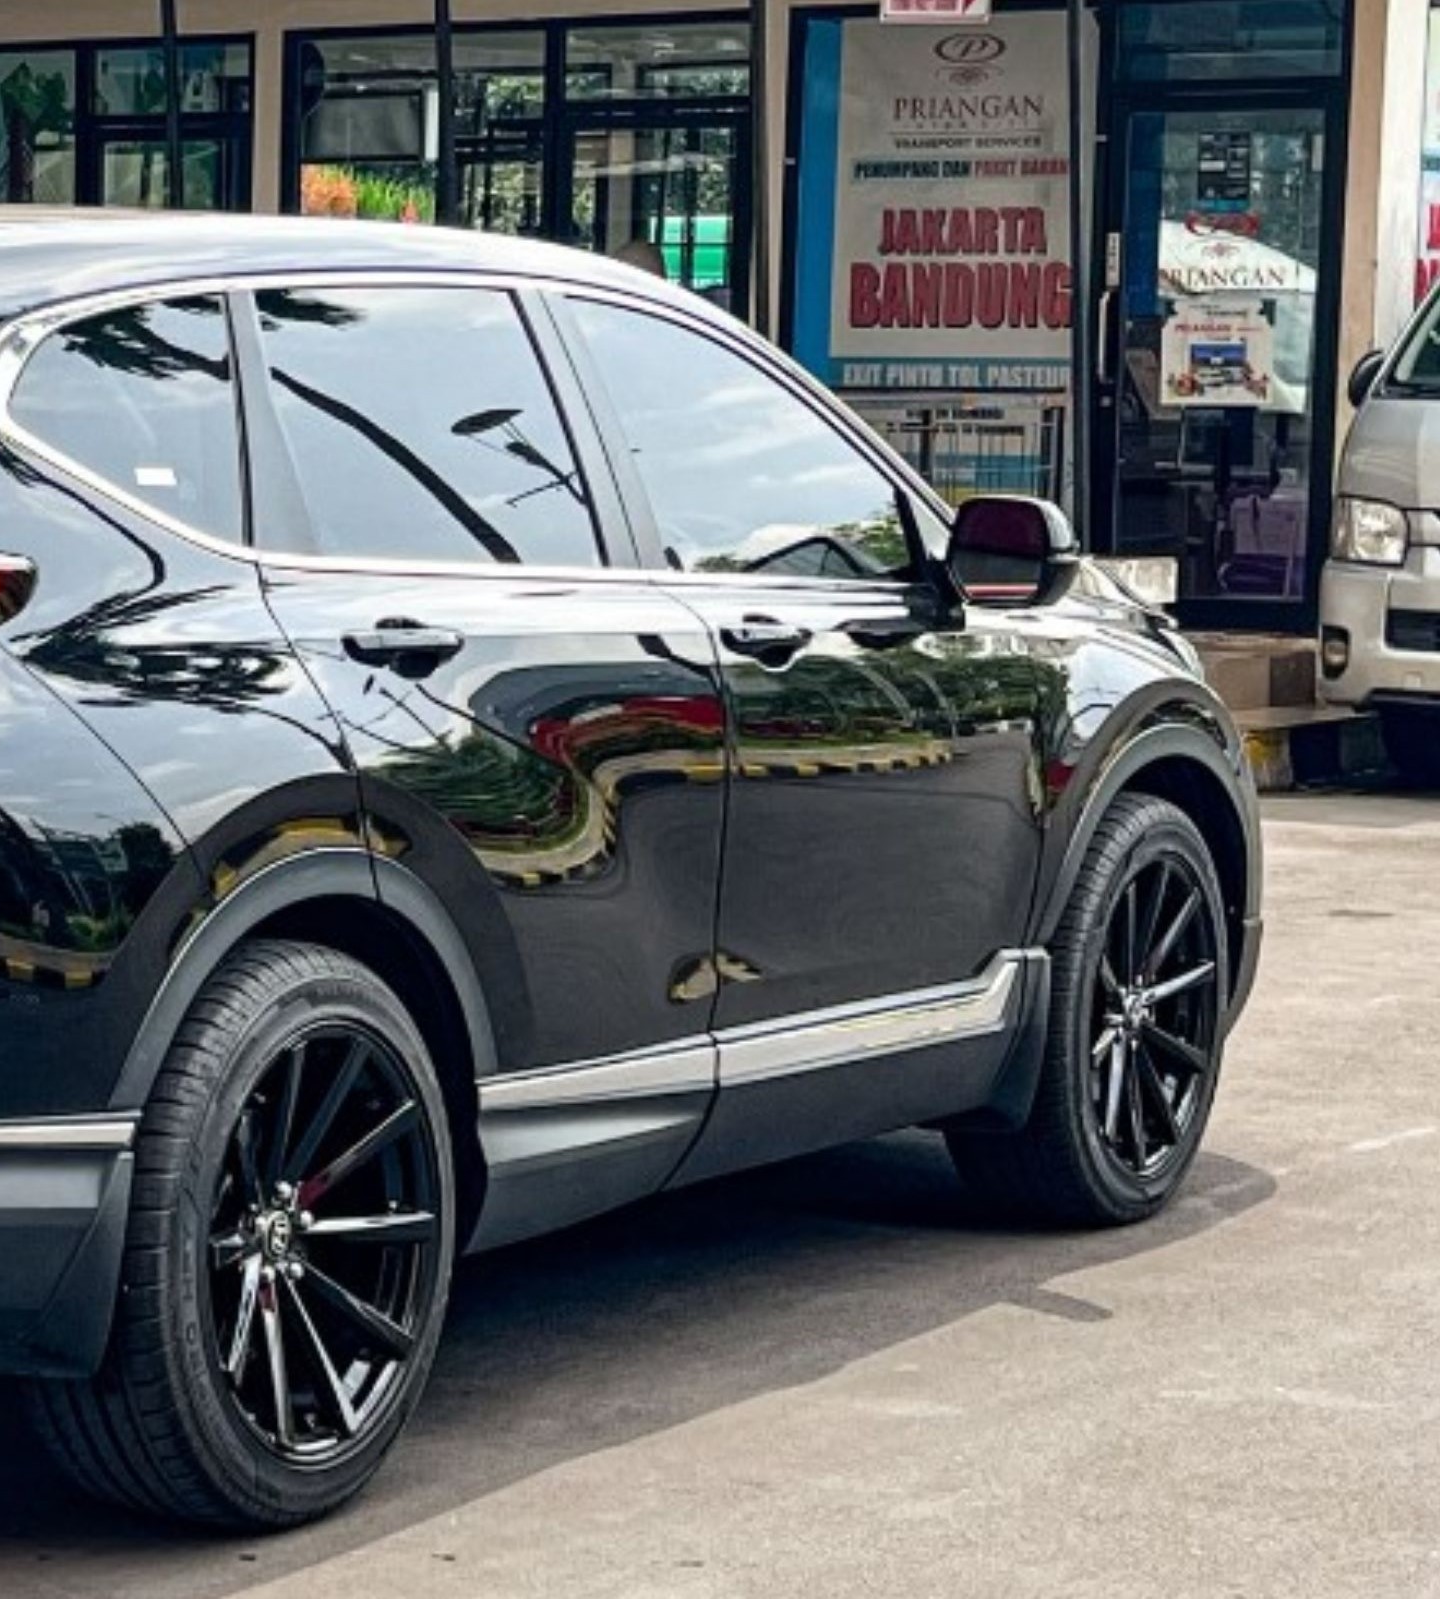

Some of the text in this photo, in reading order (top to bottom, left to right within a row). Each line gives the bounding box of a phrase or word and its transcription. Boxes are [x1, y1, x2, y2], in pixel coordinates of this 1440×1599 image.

[893, 94, 1044, 120] PRIANGAN
[878, 206, 1047, 255] JAKARTA
[850, 262, 1072, 329] BANDUNG
